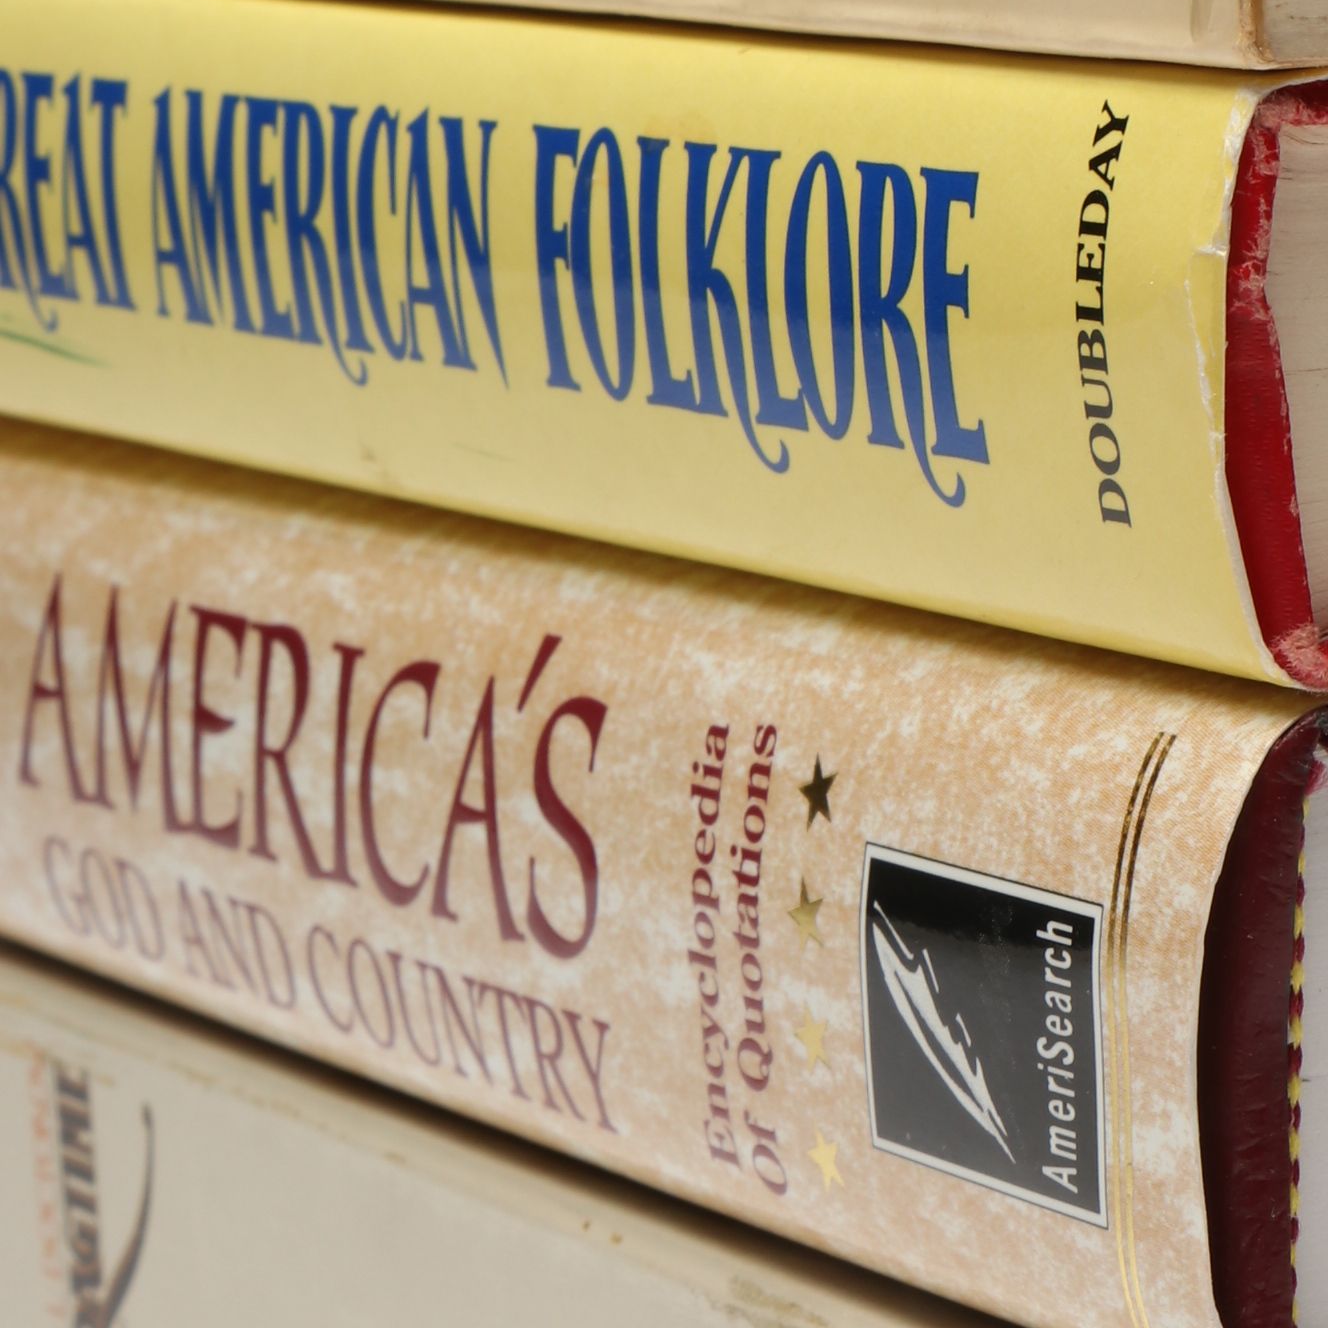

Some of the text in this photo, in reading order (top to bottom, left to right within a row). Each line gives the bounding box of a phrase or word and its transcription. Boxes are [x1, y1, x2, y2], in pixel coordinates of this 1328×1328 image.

[150, 84, 510, 391] AMERICAN
[532, 123, 990, 508] FOLKLORE
[1074, 100, 1133, 529] DOUBLEDAY
[18, 571, 609, 961] AMERICA'S
[686, 723, 742, 1172] Encyclopedia
[730, 721, 789, 1197] Of Quotations
[42, 833, 620, 1135] GOD AND COUNTRY
[1035, 918, 1079, 1194] AmeriSearch
